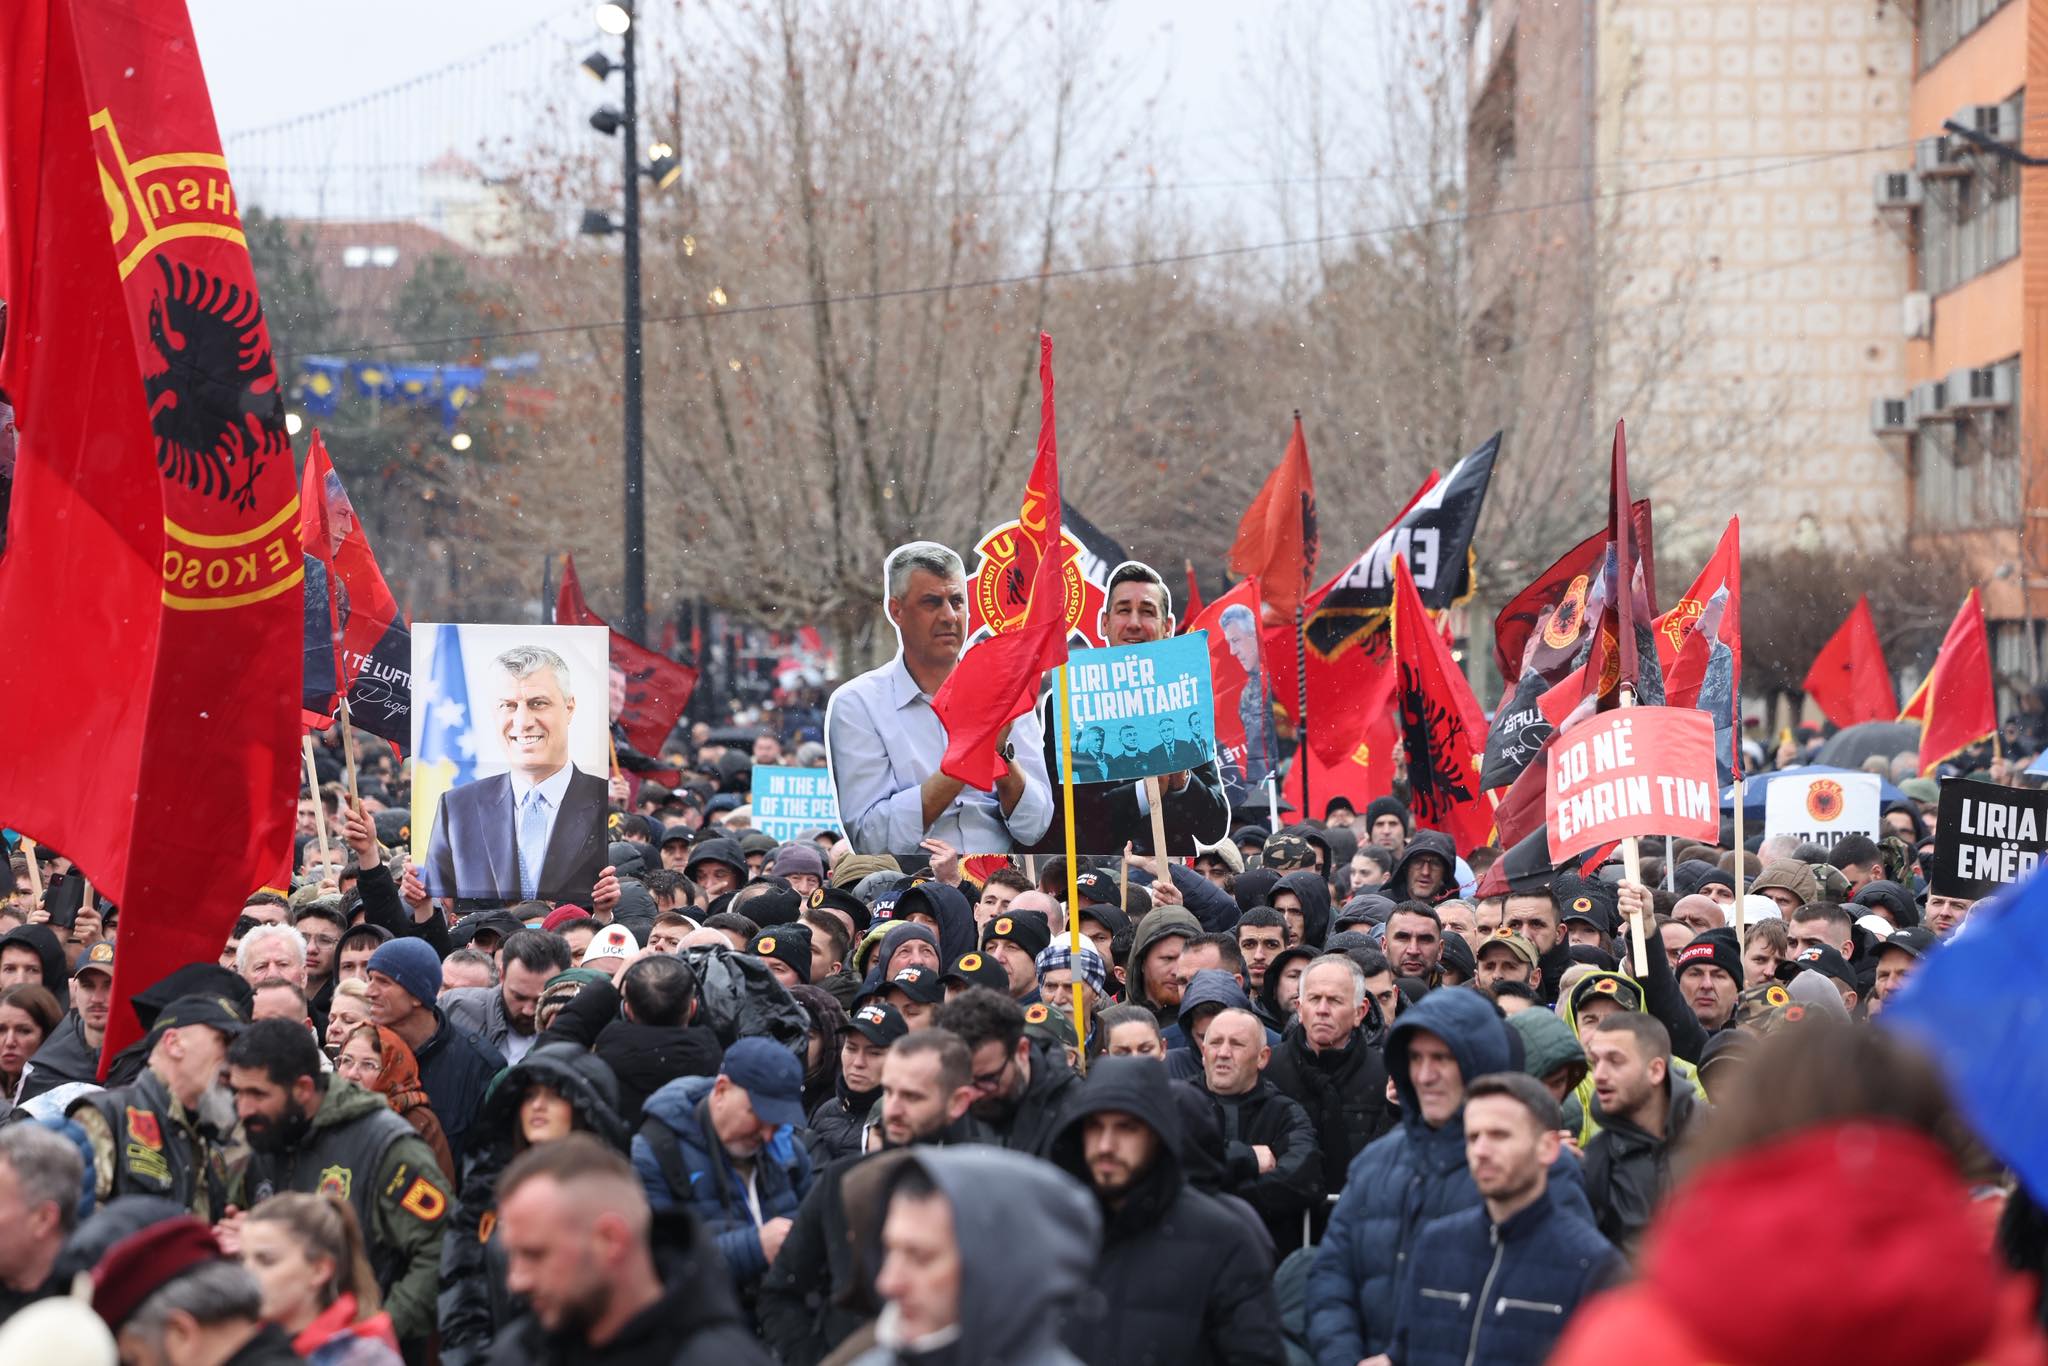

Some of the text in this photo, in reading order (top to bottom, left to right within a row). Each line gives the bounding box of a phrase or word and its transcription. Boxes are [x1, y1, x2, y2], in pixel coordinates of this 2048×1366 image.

[983, 565, 997, 619] USHTRIA
[352, 653, 374, 673] TË
[1070, 654, 1156, 692] LIRI PËR
[1071, 672, 1199, 730] ÇLIRIMTARËT
[1557, 718, 1635, 793] JO NË
[761, 796, 778, 816] OF
[782, 797, 809, 817] THE
[770, 776, 785, 795] IN
[788, 776, 815, 796] THE
[1557, 775, 1711, 842] EMRIN TIM
[1961, 798, 2038, 841] LIRIA
[1958, 841, 2039, 884] EMËR
